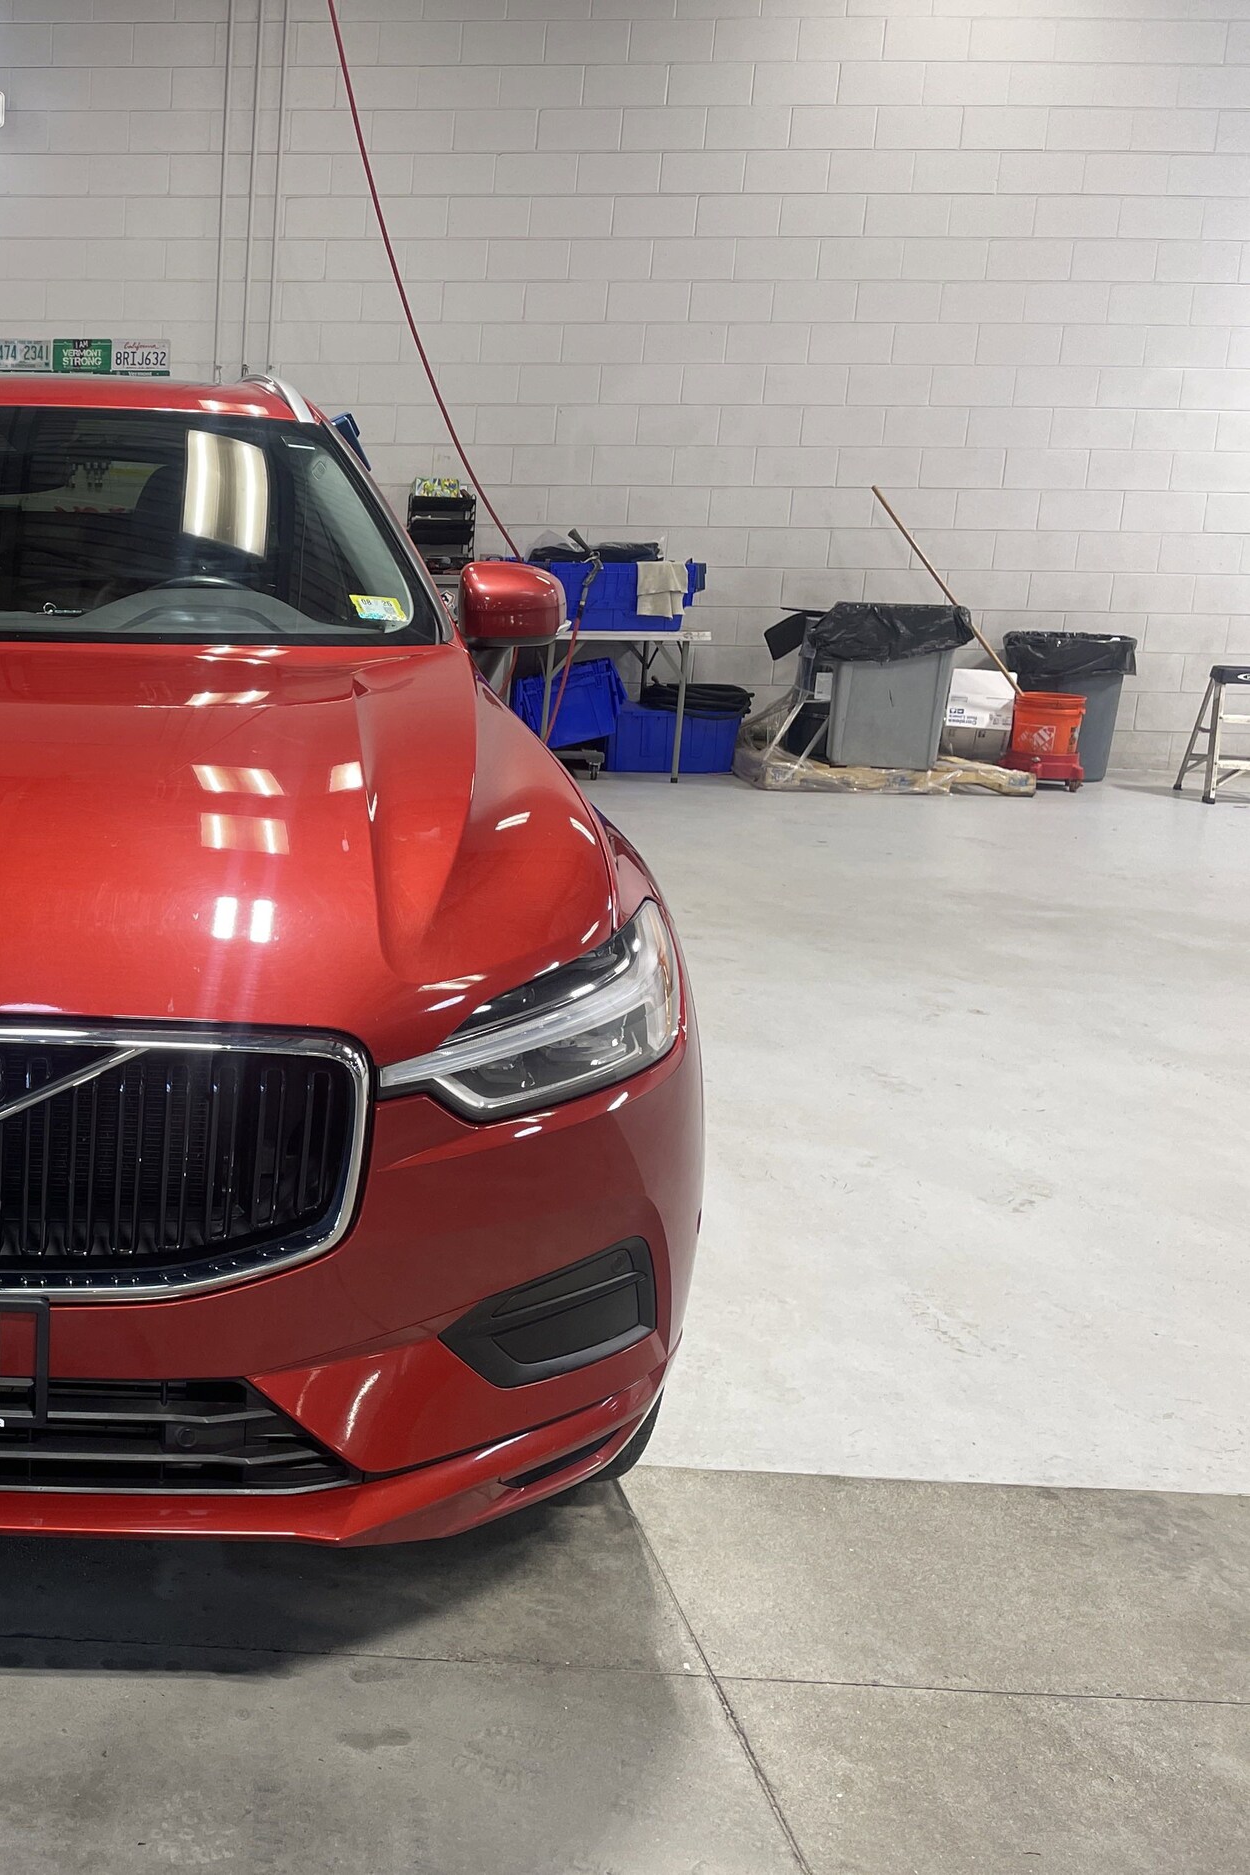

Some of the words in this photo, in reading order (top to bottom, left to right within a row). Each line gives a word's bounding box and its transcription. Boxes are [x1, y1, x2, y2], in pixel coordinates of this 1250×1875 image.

[124, 341, 159, 351] California
[23, 344, 49, 361] 2341
[62, 349, 102, 357] VERMONT
[62, 356, 102, 366] STRONG
[115, 351, 167, 366] 8RIJ632
